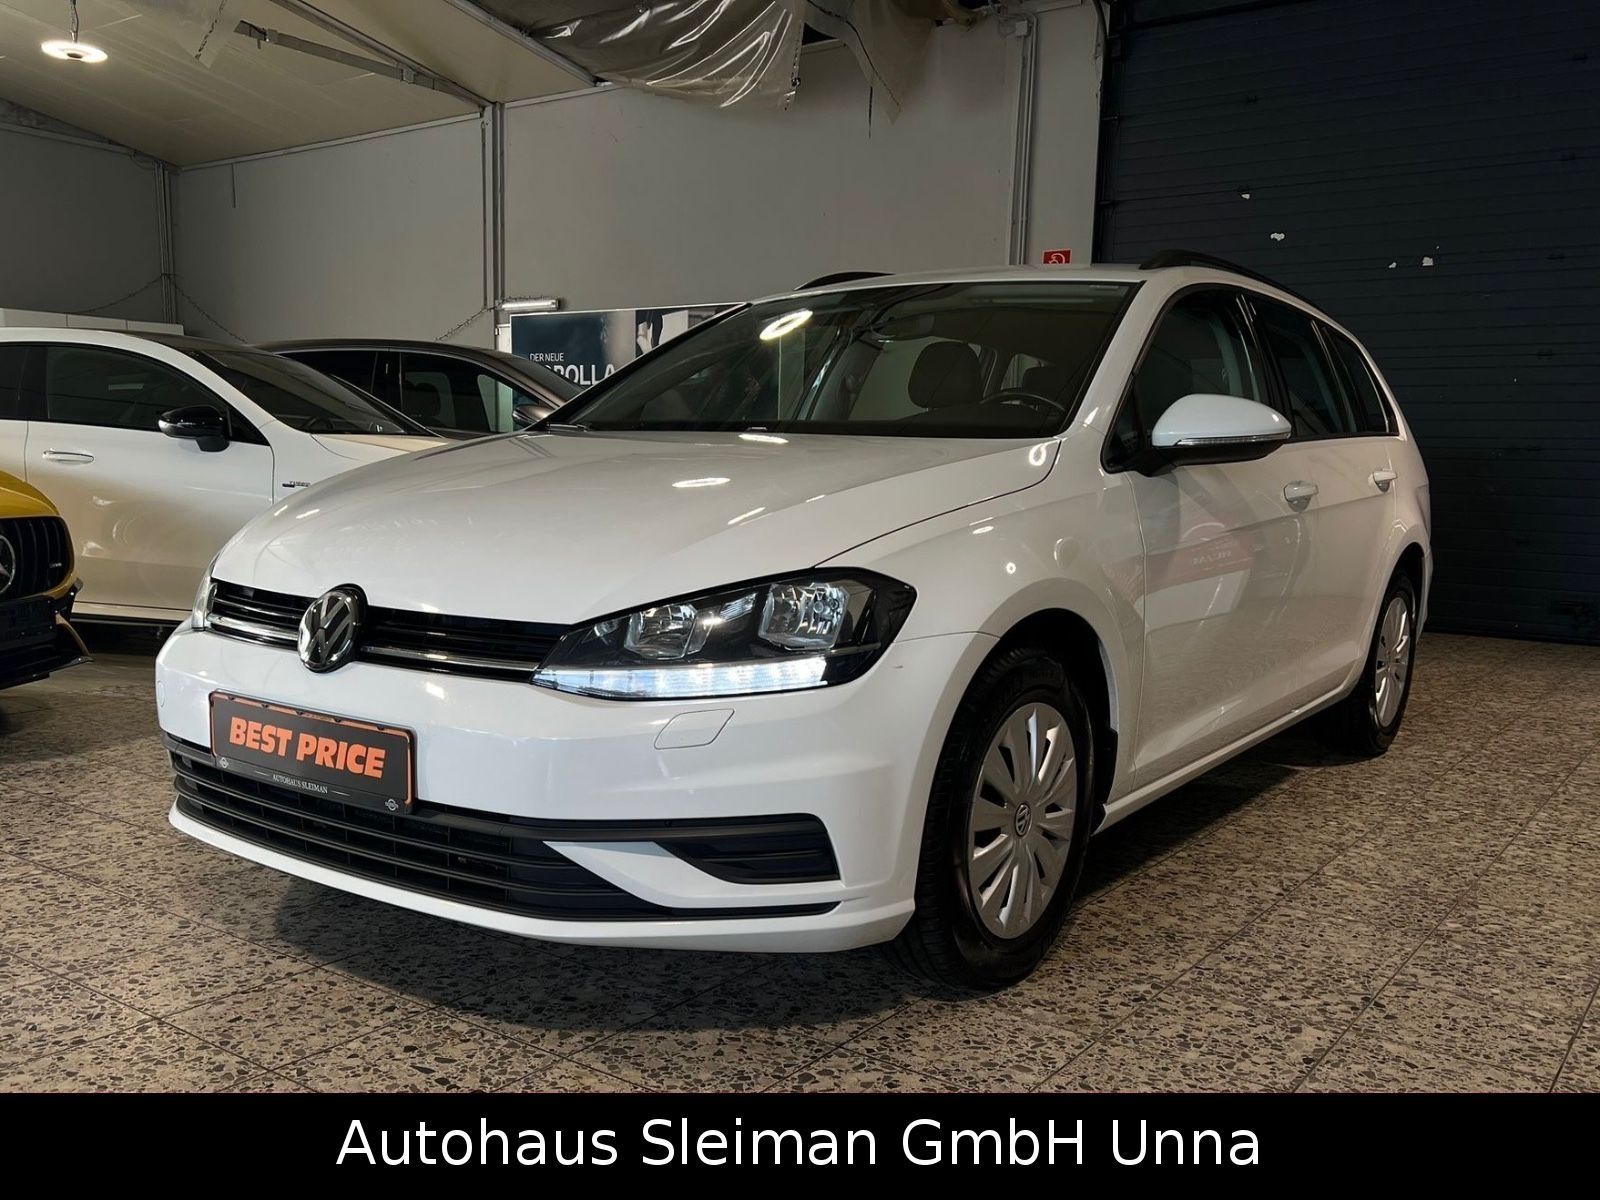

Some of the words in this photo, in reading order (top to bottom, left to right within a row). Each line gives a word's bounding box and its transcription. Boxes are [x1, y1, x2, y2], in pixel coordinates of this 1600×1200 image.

[529, 352, 544, 362] DER
[544, 352, 564, 362] NEUE
[229, 716, 292, 757] BEST
[296, 733, 386, 779] PRICE
[272, 773, 301, 791] AUTOHAUS
[301, 780, 328, 794] SLEIMAN
